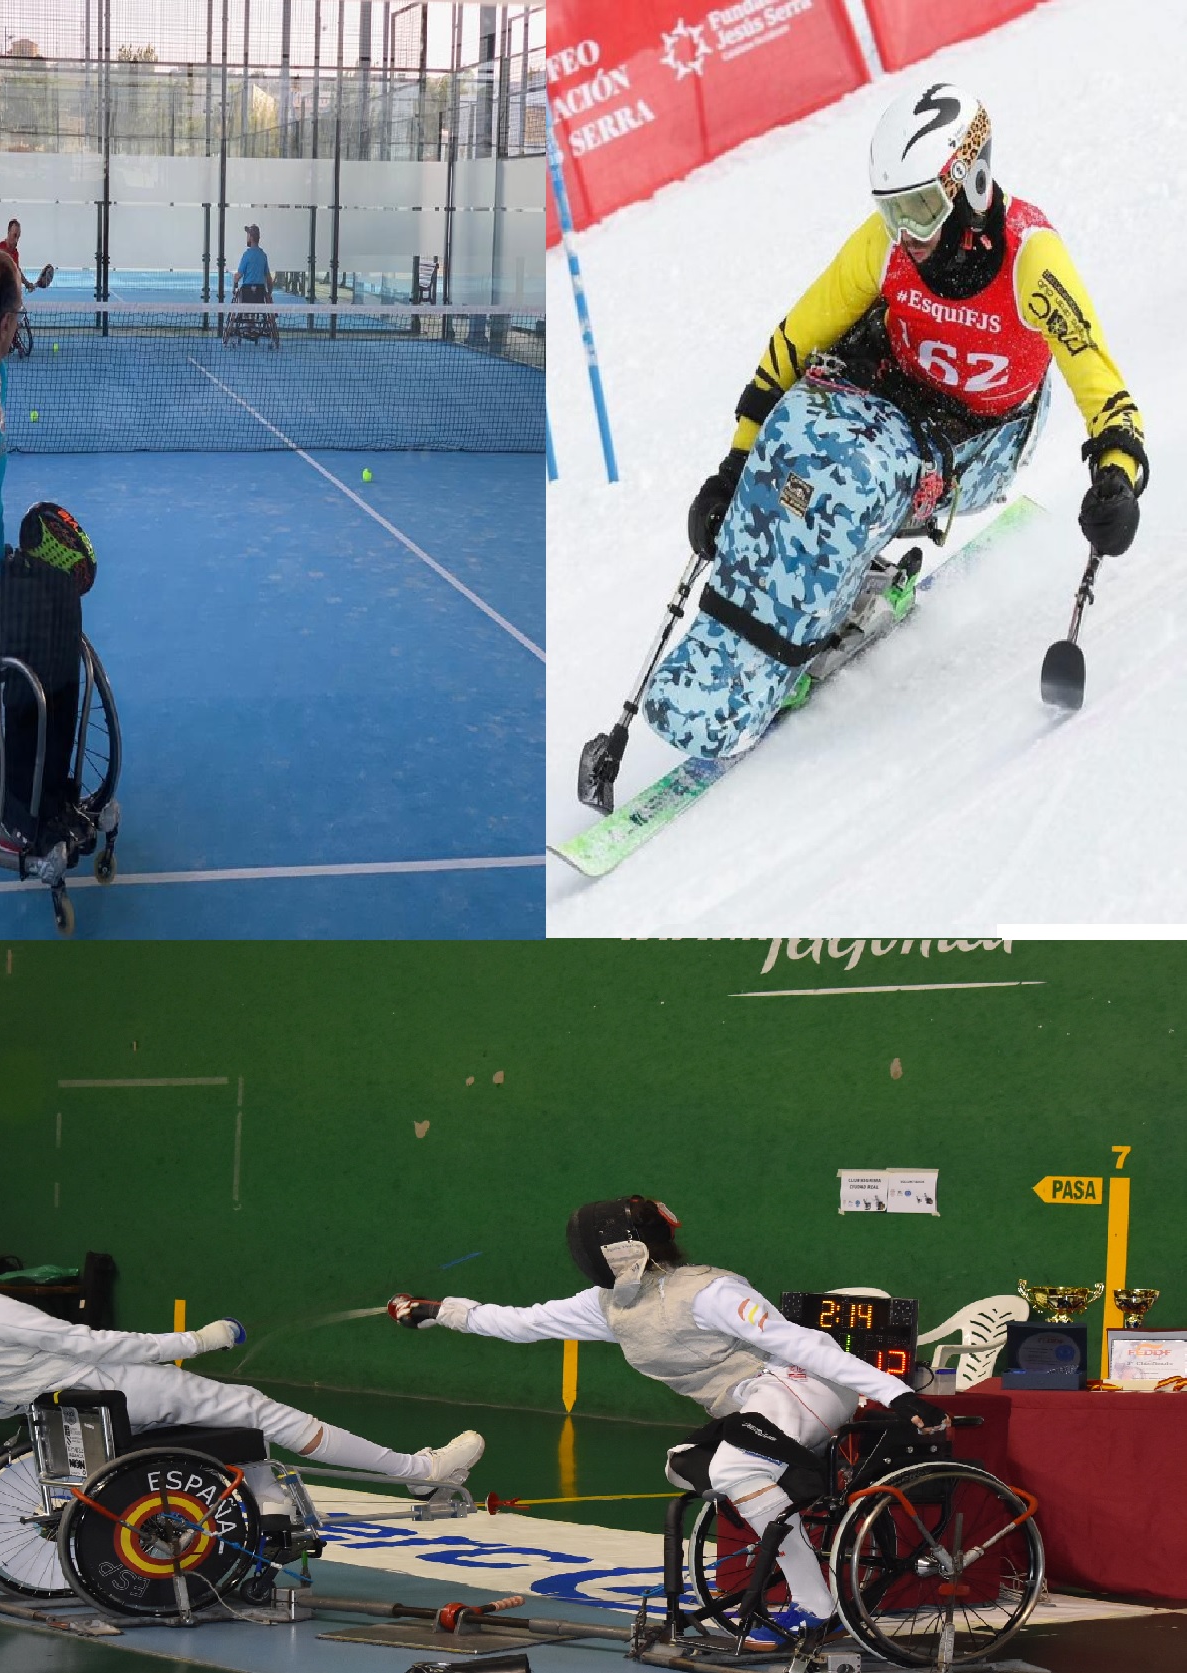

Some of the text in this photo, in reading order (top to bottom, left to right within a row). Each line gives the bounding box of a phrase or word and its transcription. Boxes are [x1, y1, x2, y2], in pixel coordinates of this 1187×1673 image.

[569, 99, 656, 157] SERRA
[919, 339, 1010, 393] 62
[1112, 1146, 1132, 1170] 7
[1052, 1179, 1097, 1200] PASA
[820, 1300, 873, 1329] 2:14
[147, 1470, 238, 1536] ESPAÑA
